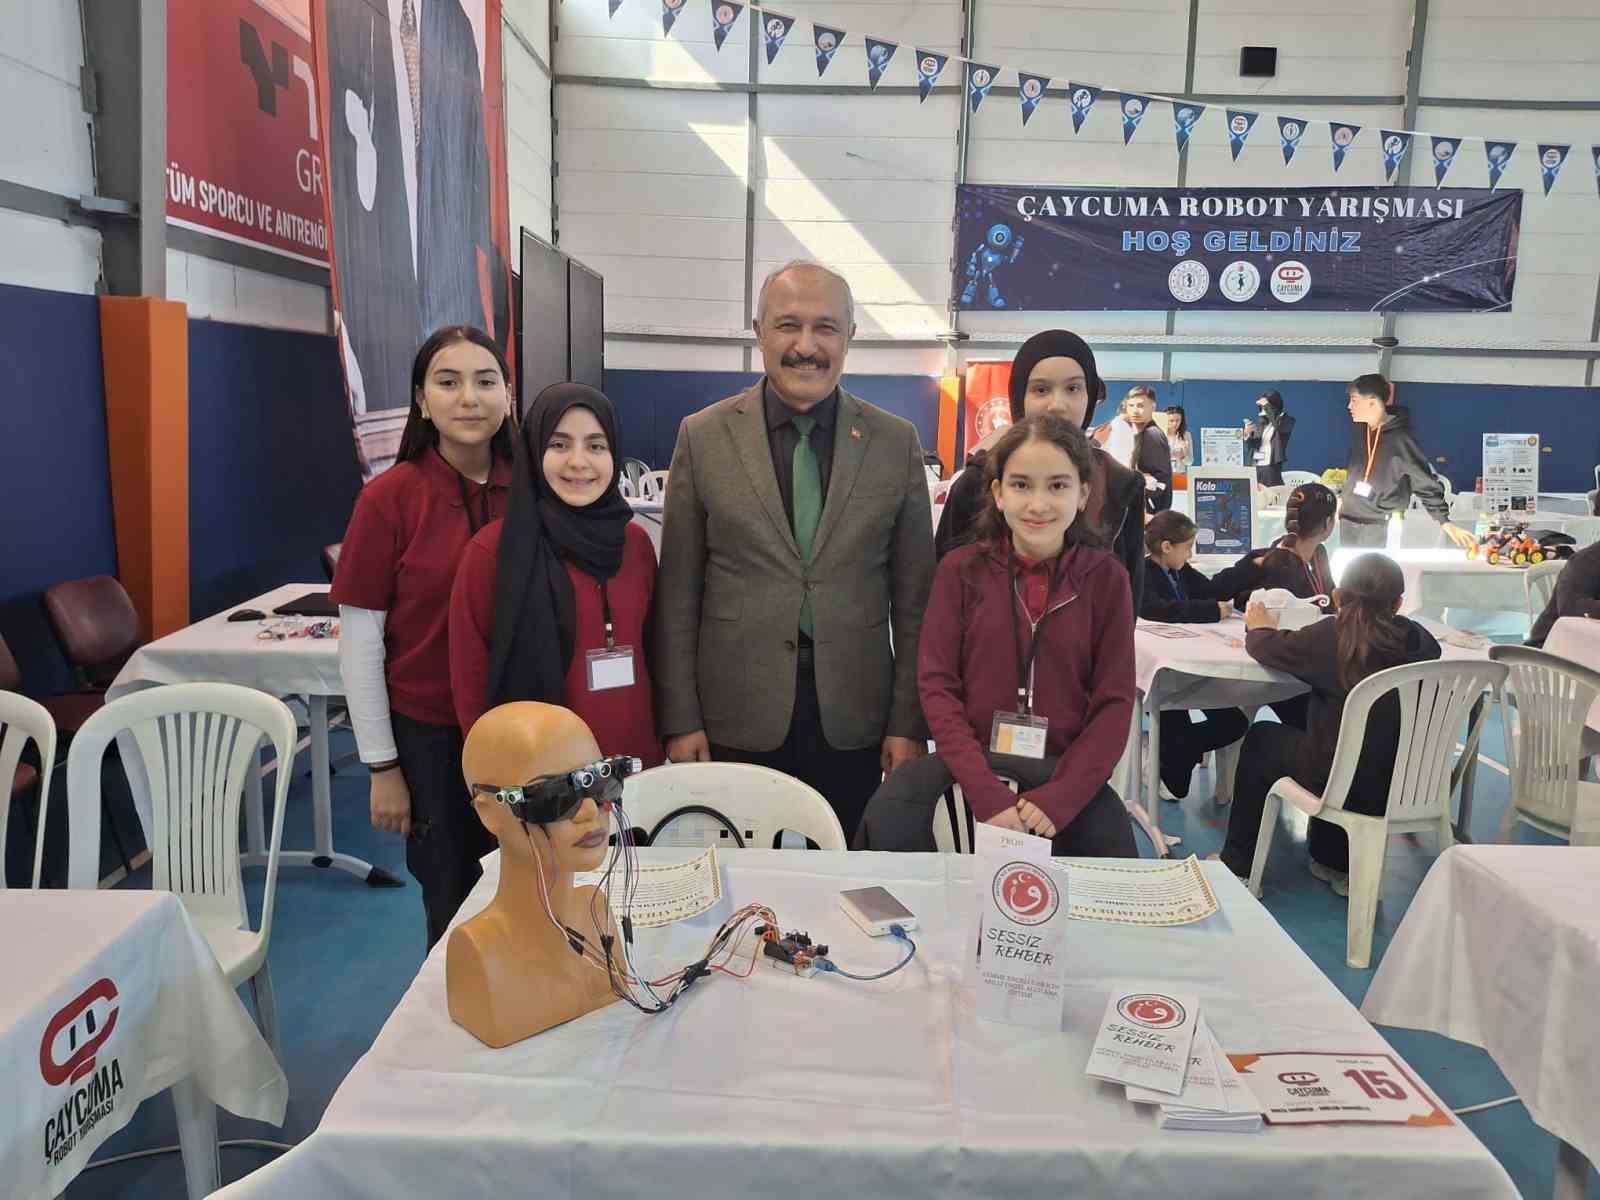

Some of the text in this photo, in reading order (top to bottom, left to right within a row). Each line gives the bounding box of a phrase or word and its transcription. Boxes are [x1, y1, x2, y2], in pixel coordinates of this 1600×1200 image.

[199, 180, 254, 227] SPORCU
[256, 201, 273, 233] VE
[1016, 195, 1465, 224] ÇAYCUMA ROBOT YARIŞMASI
[1122, 226, 1361, 257] HOŞ GELDİNİZ
[994, 944, 1054, 966] REHBER
[1343, 1068, 1408, 1101] 15
[45, 1058, 124, 1166] ÇAYCUMA
[53, 1131, 78, 1167] ROBOT
